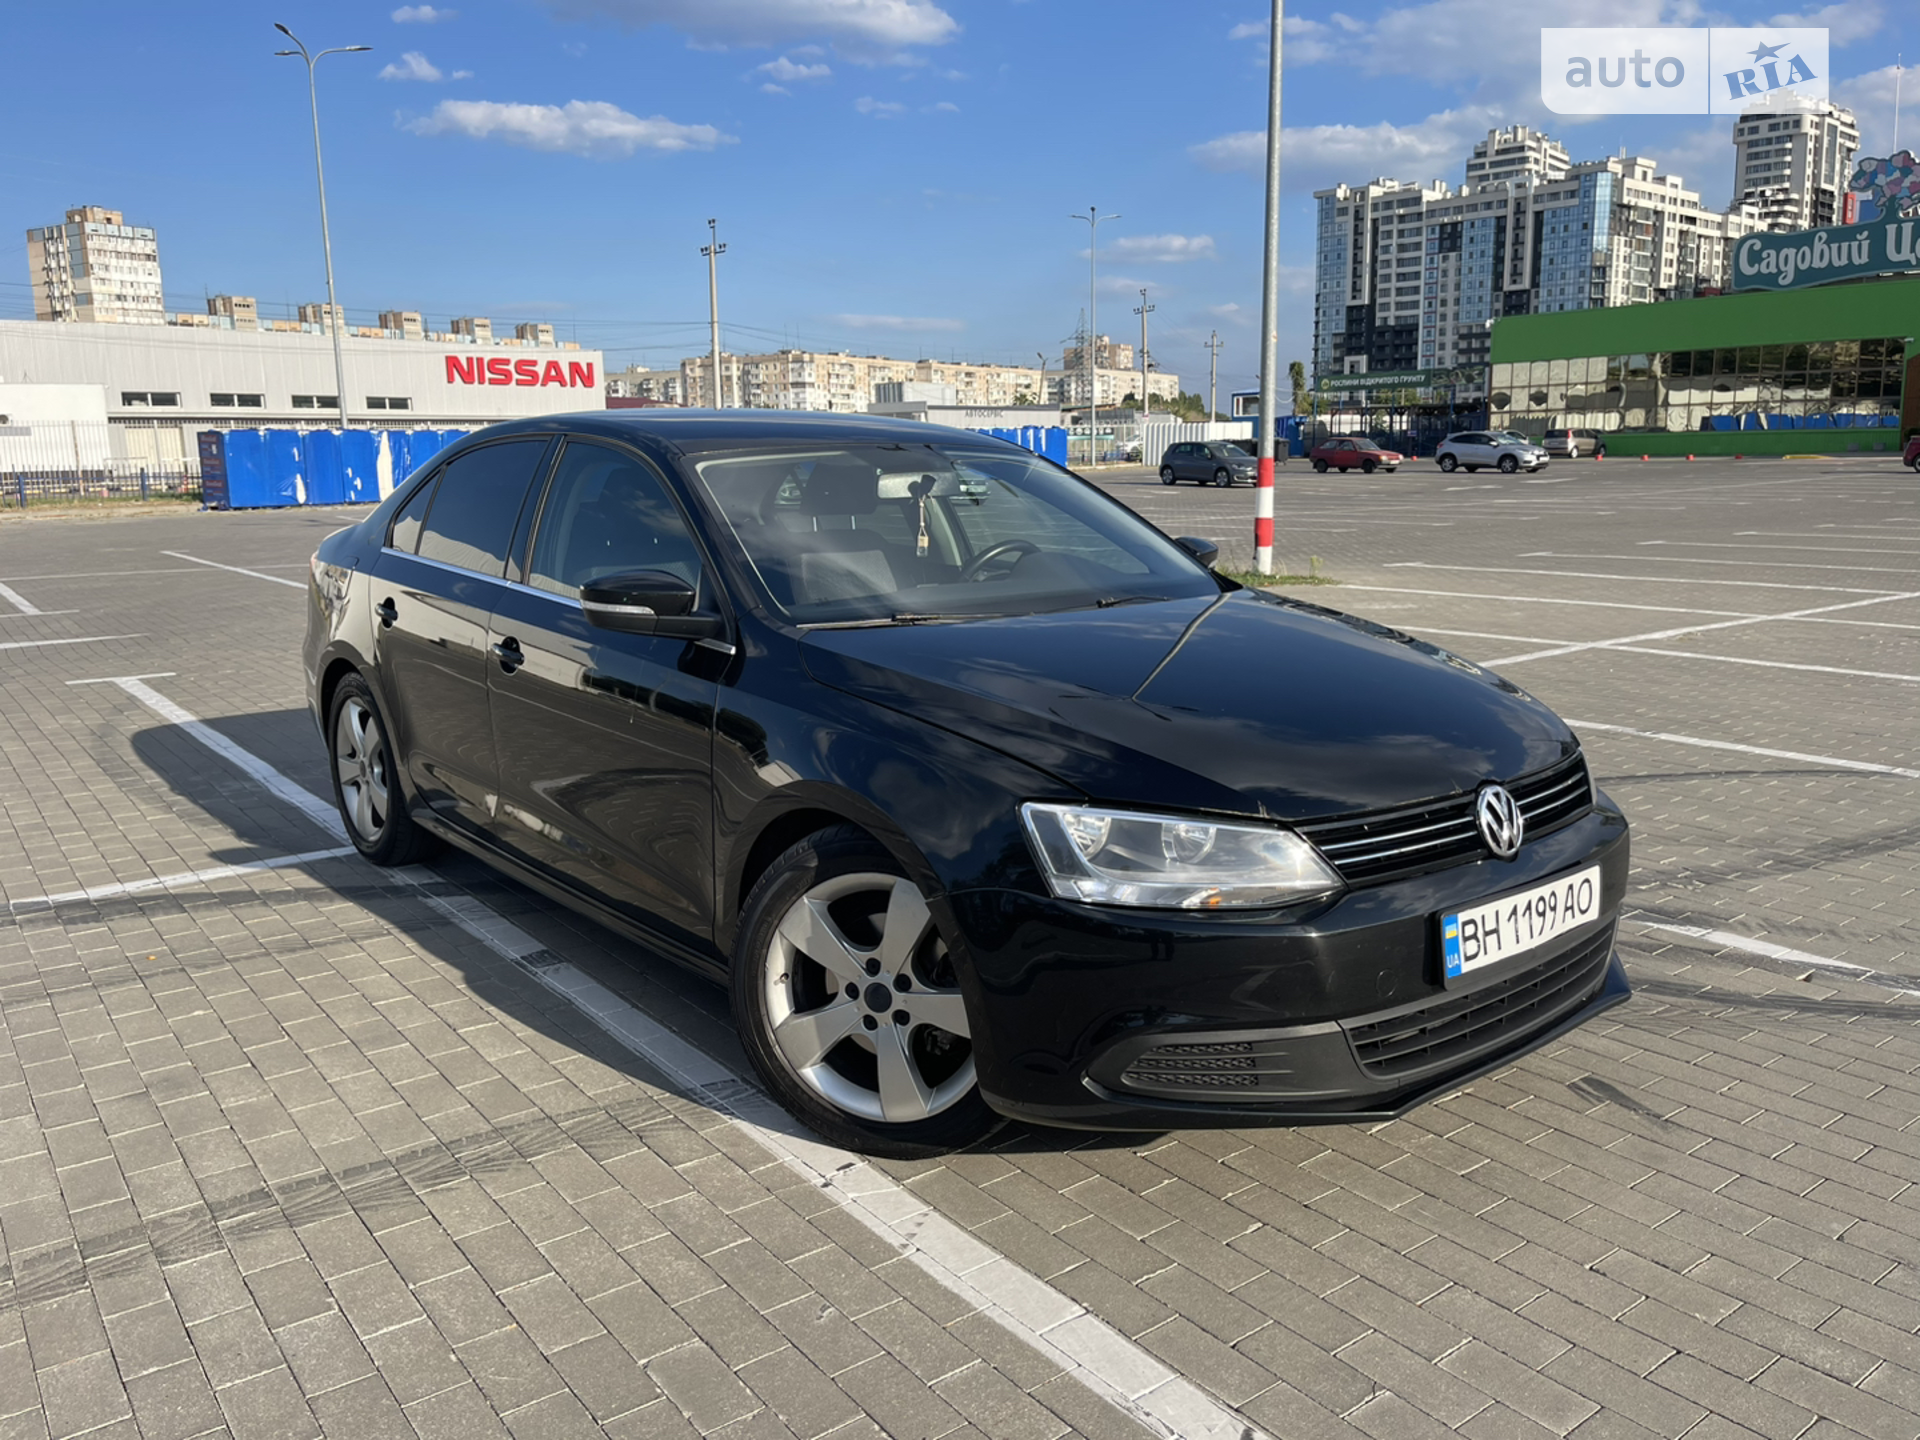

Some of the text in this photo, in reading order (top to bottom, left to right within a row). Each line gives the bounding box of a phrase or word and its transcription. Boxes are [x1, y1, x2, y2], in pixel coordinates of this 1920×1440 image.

[1738, 230, 1871, 287] Садовий
[445, 354, 595, 389] NISSAN
[1330, 378, 1360, 388] РОСЛИНИ
[1460, 877, 1593, 963] BH 1199 AO
[1446, 952, 1460, 969] UA
